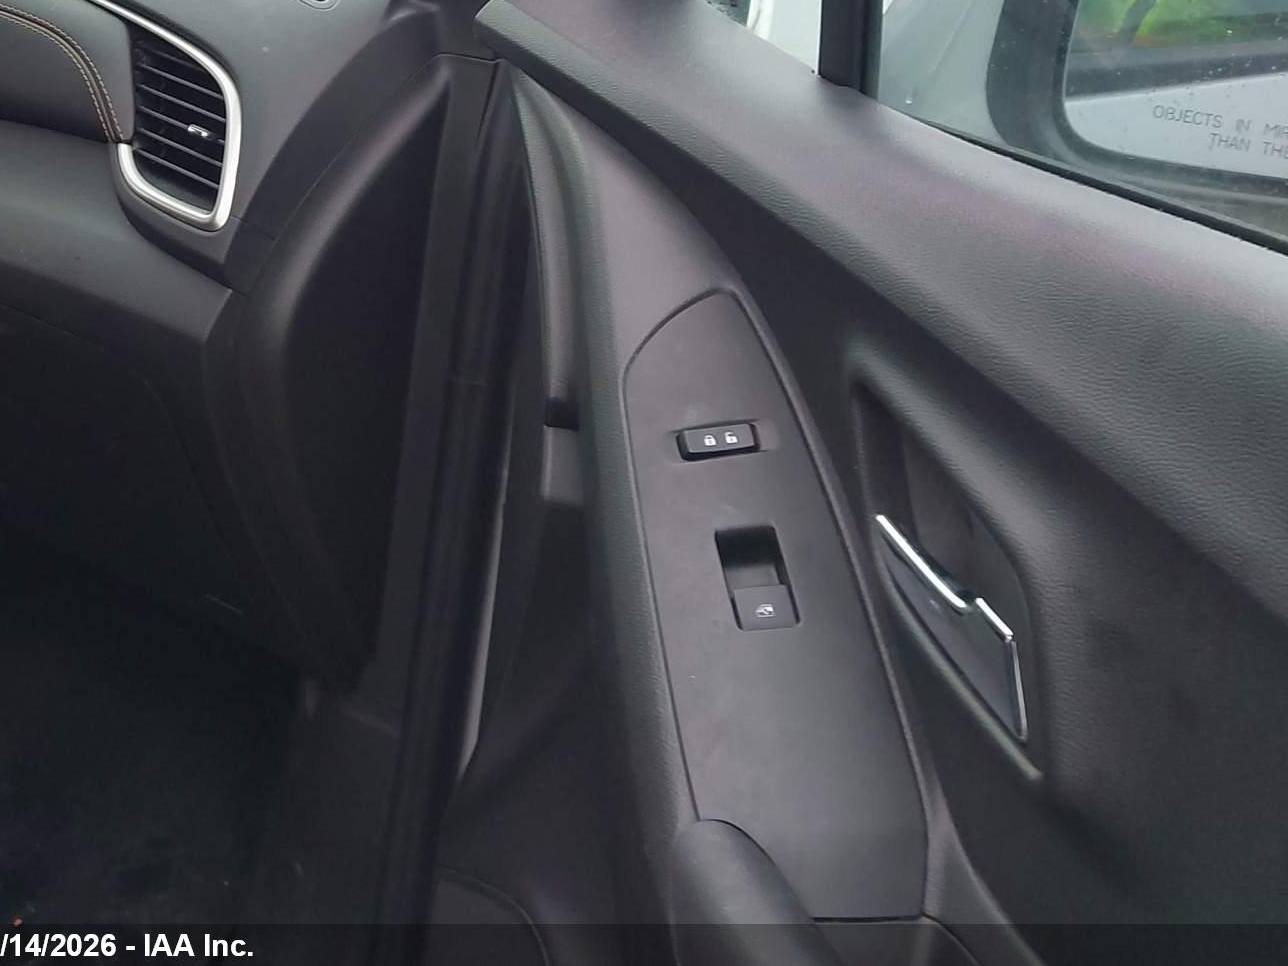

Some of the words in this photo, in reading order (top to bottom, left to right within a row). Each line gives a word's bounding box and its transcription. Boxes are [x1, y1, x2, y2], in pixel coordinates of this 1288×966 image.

[1153, 105, 1223, 129] OBJECTS
[1234, 117, 1253, 133] IN
[1209, 133, 1250, 151] THAN
